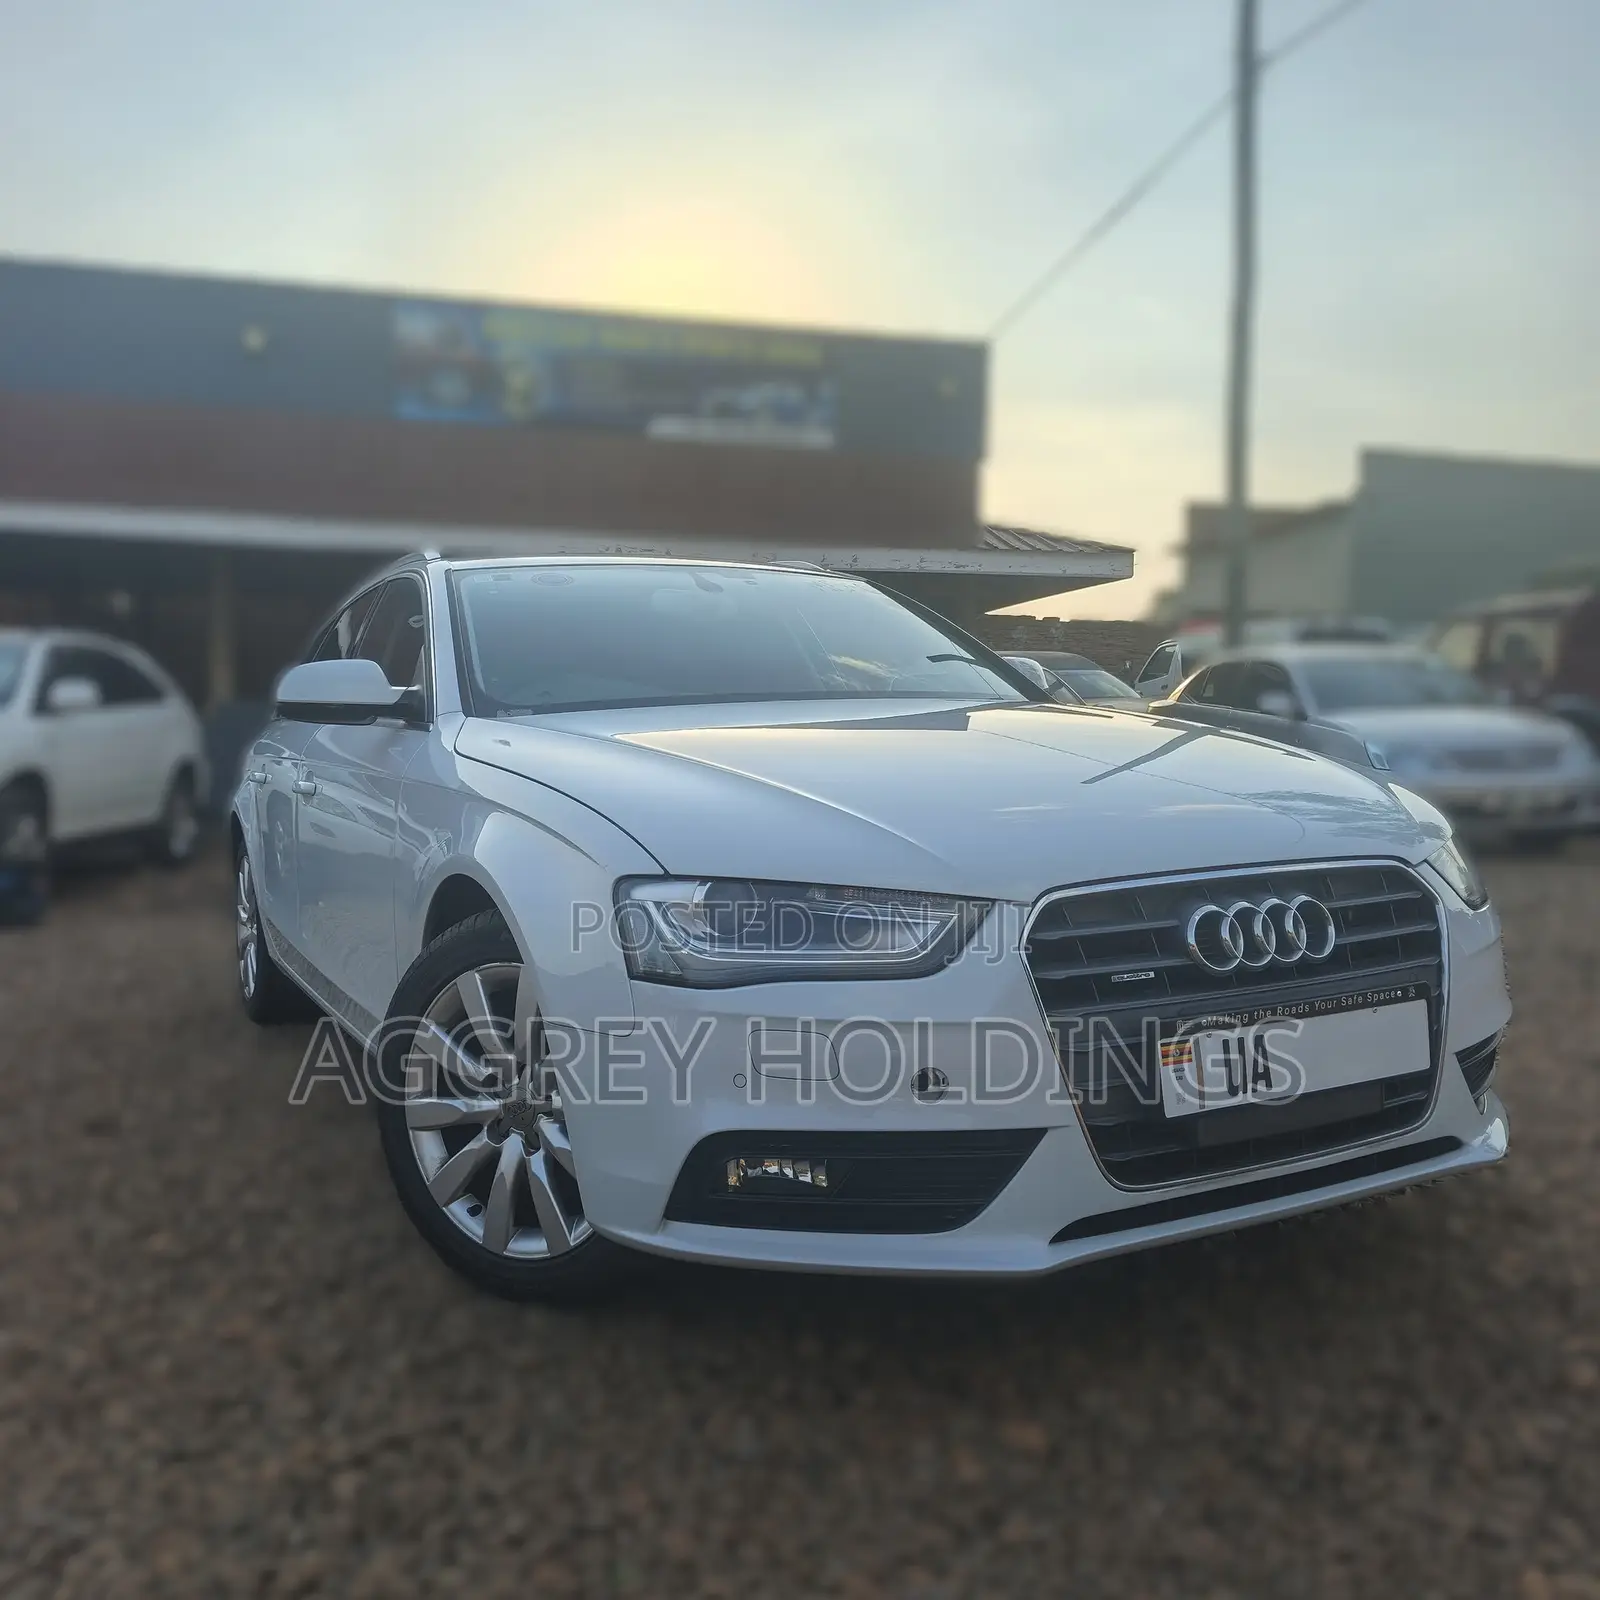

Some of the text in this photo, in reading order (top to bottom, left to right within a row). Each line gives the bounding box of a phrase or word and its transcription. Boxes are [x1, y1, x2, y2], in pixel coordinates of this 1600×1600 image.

[1207, 989, 1396, 1026] Making the Roads Your Safe Space
[1222, 1034, 1273, 1097] UA
